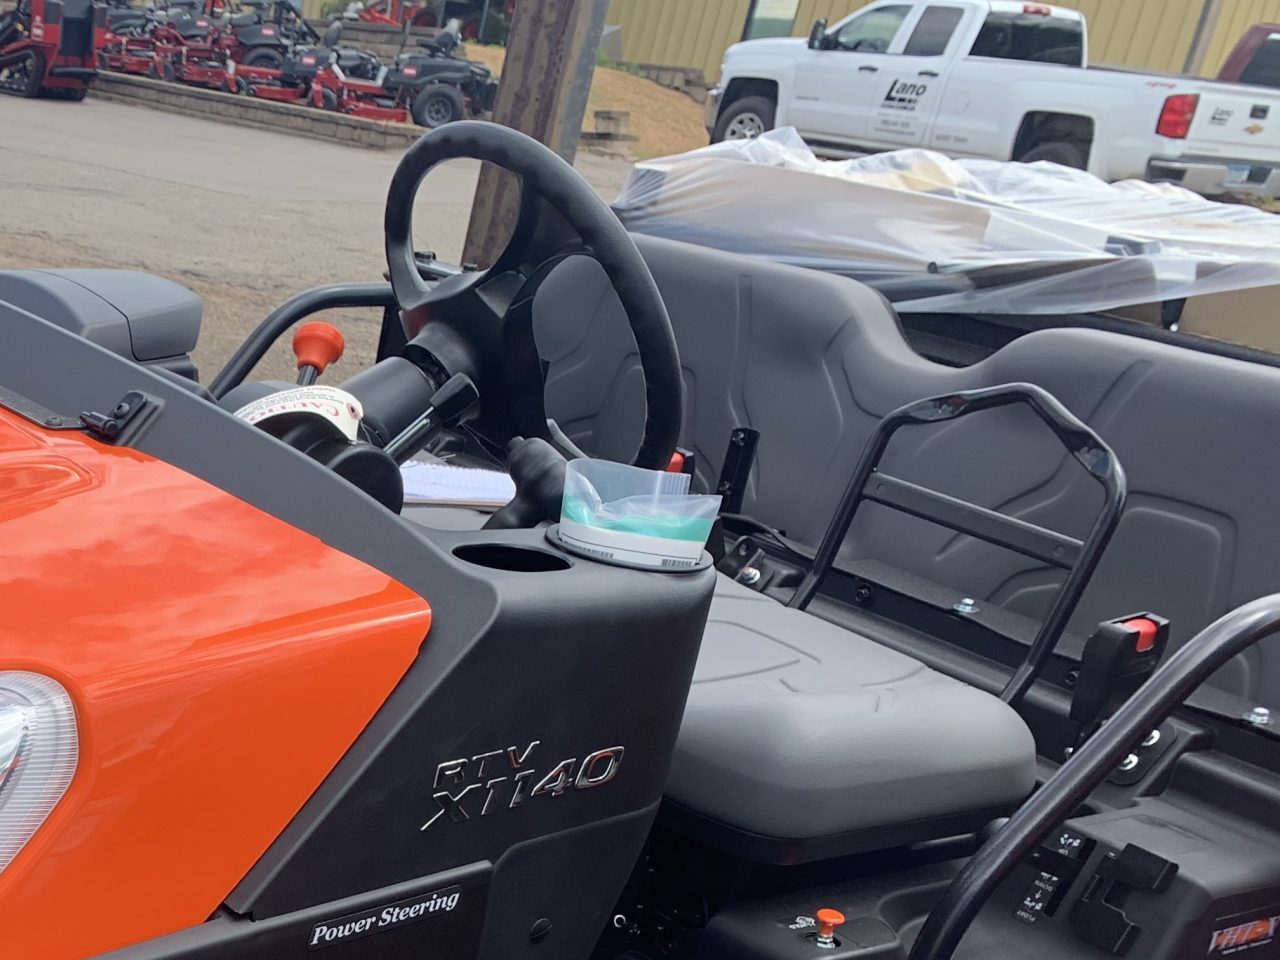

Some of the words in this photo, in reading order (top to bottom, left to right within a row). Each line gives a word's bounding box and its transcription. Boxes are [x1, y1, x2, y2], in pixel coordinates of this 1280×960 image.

[884, 79, 927, 101] Lano
[420, 746, 625, 831] X1140
[433, 740, 541, 788] RTV
[310, 913, 377, 946] Power
[377, 890, 460, 928] Steering
